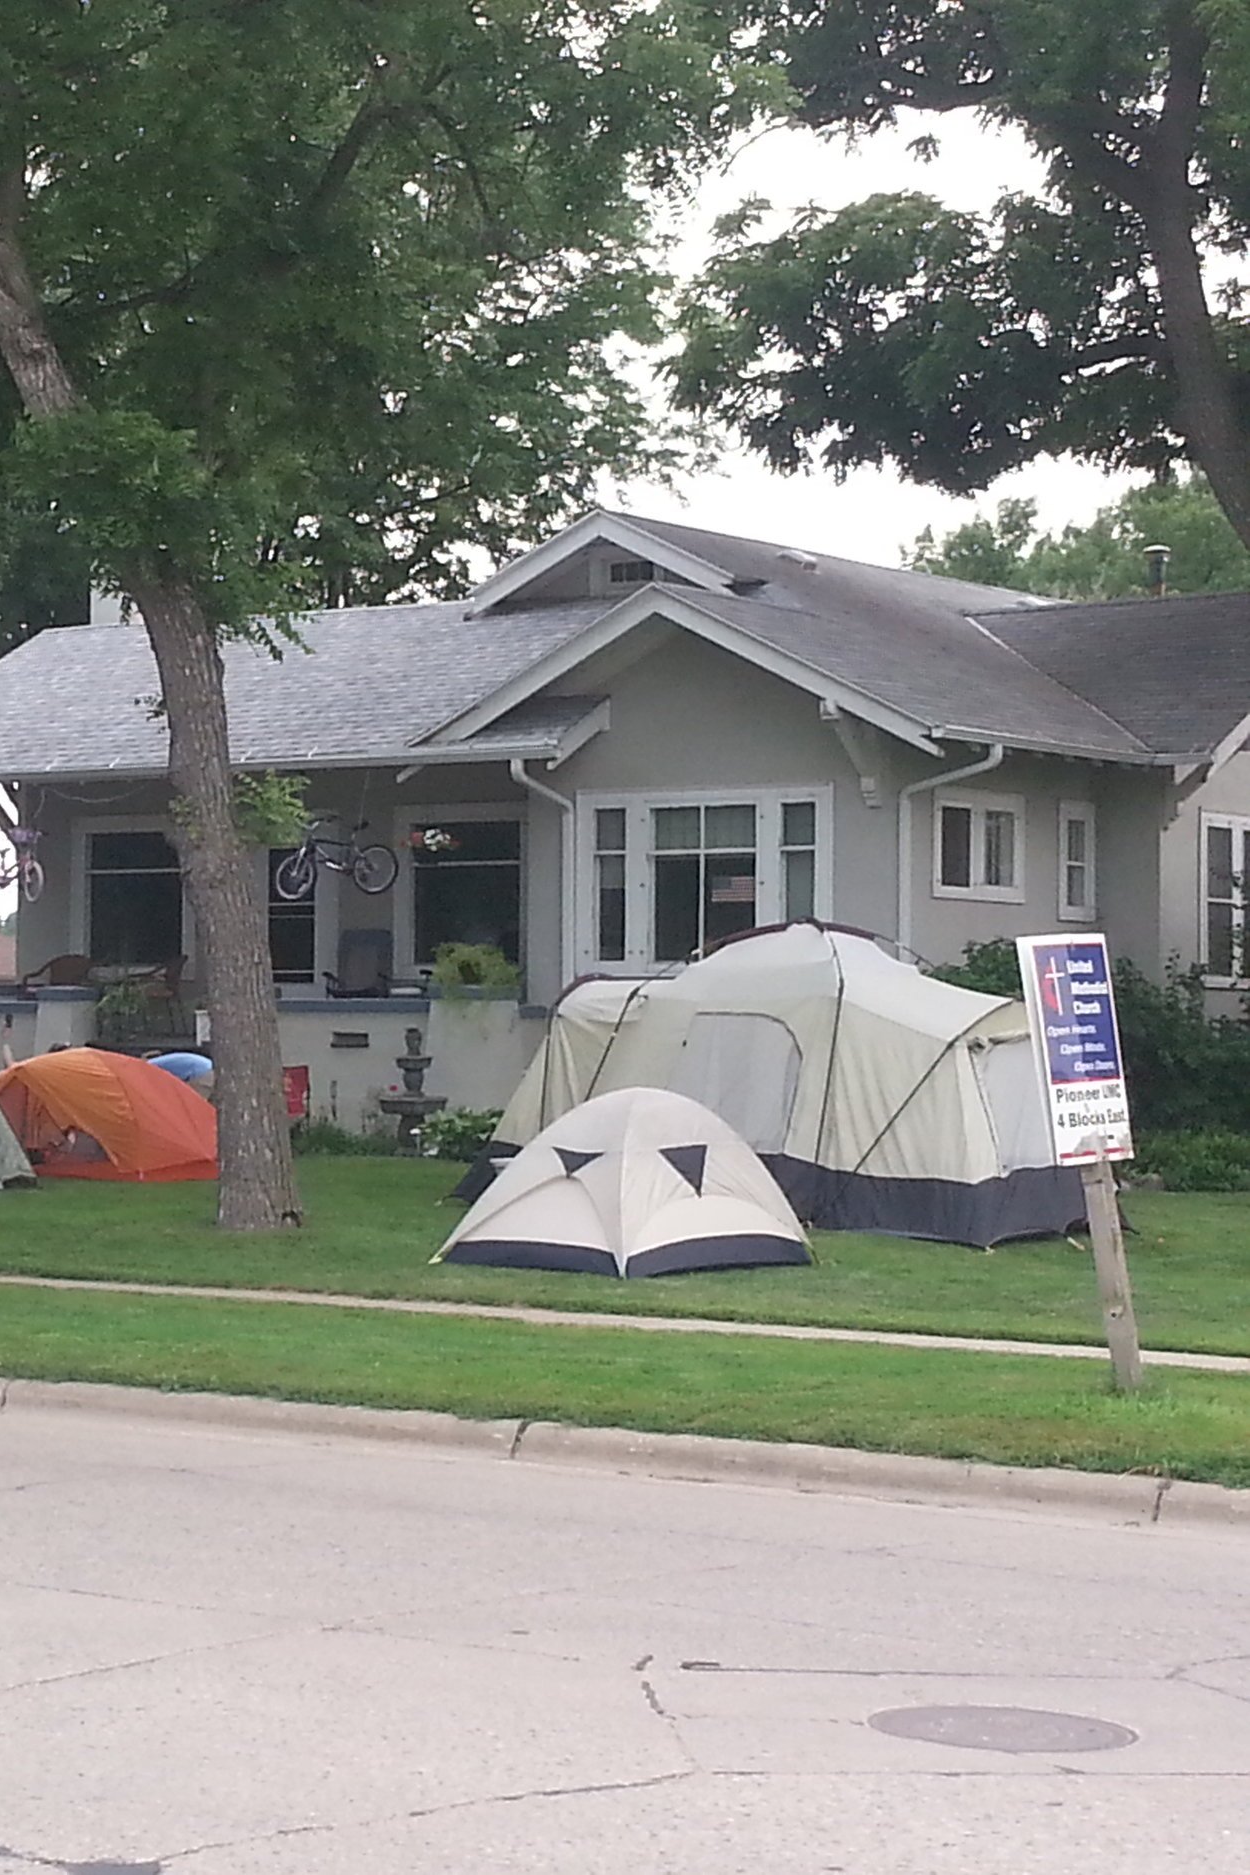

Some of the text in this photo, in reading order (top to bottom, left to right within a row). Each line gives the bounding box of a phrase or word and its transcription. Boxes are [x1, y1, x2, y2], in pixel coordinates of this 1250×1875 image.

[1066, 960, 1094, 974] United
[1072, 1000, 1102, 1015] Church
[1047, 1026, 1070, 1038] Open
[1060, 1043, 1083, 1055] Open
[1055, 1086, 1100, 1103] Pioneer
[1057, 1113, 1065, 1128] 4
[1068, 1111, 1106, 1127] Blocks
